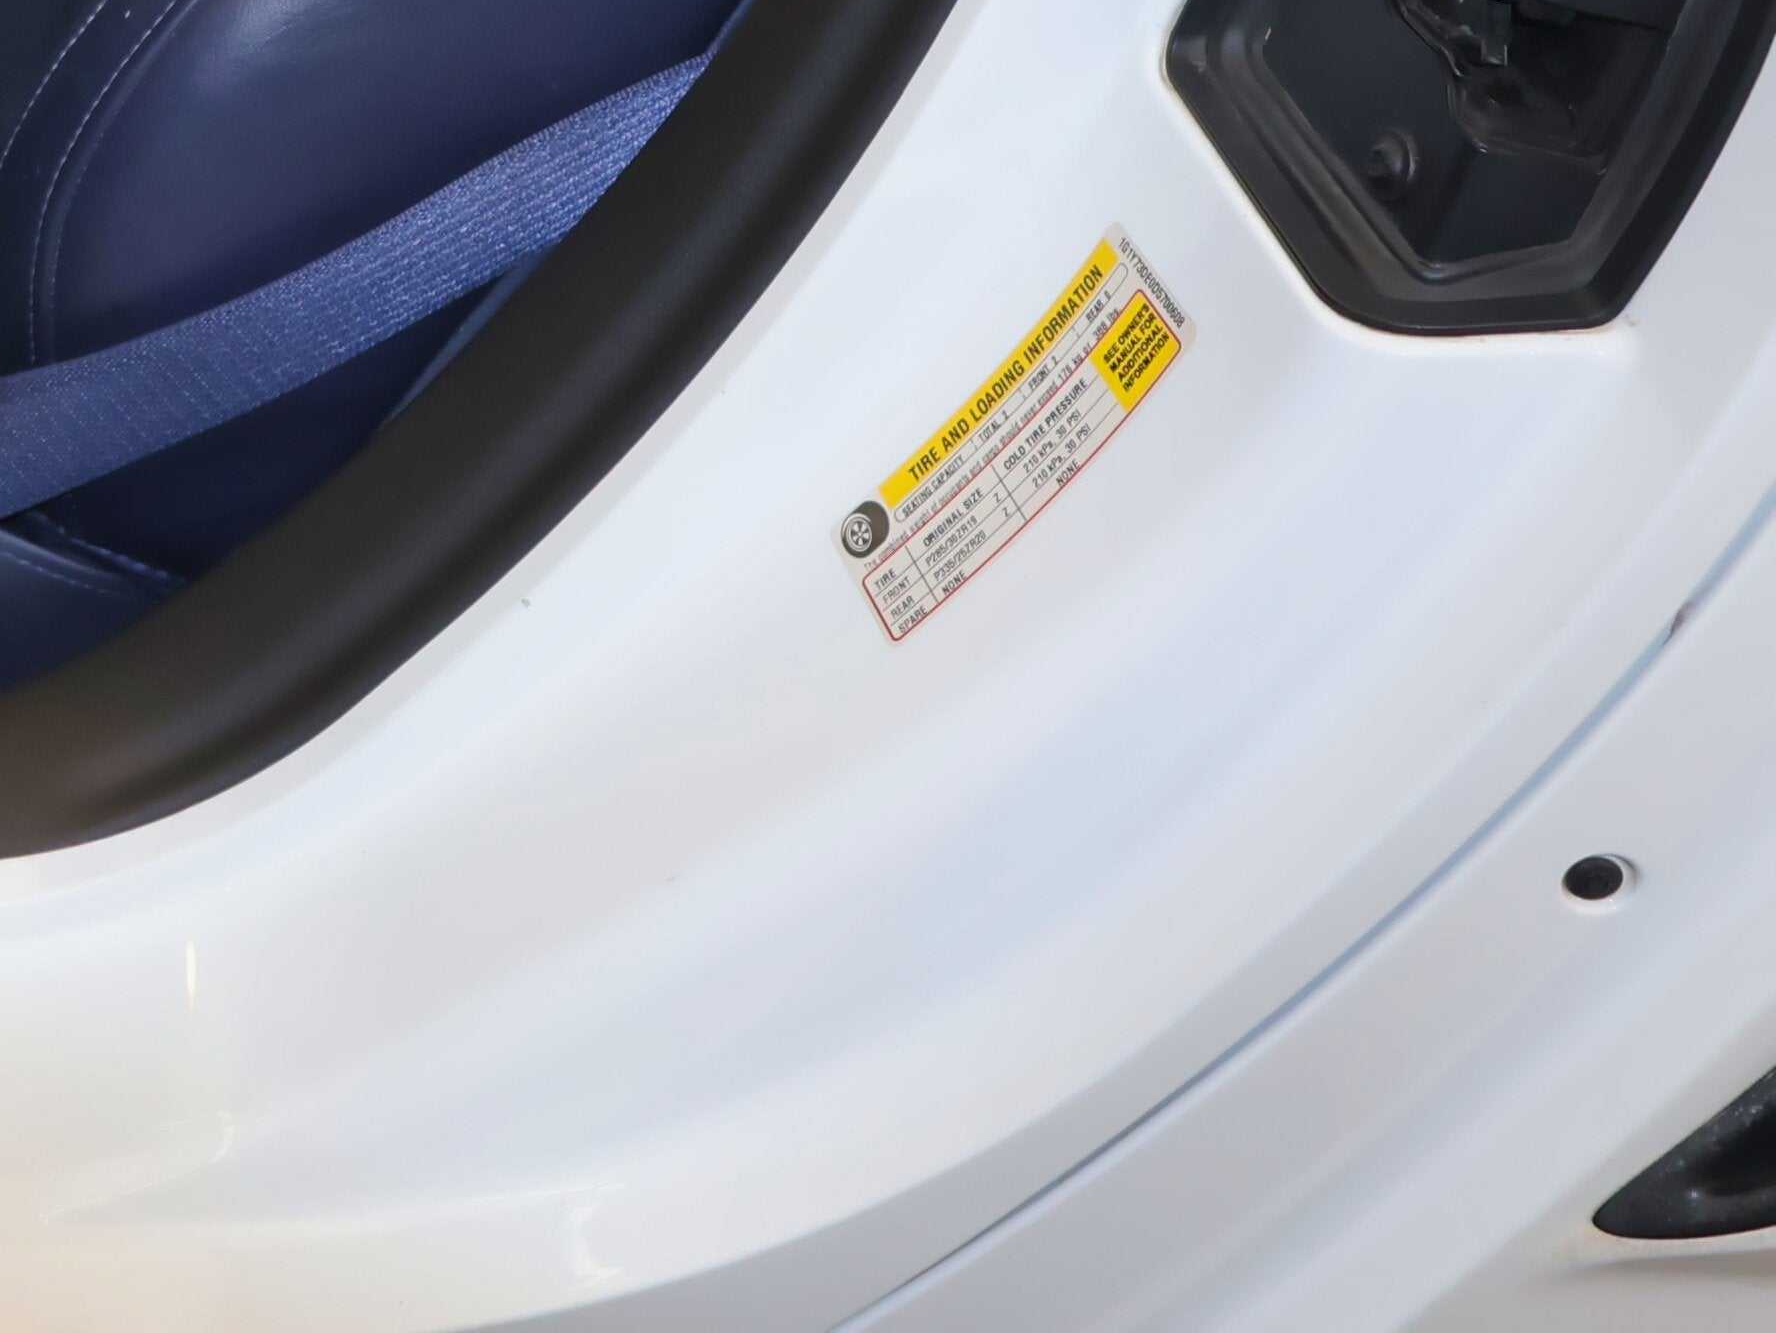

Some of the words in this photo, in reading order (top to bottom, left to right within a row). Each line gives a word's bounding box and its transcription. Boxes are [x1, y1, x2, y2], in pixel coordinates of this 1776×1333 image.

[1086, 299, 1104, 324] REAR
[1103, 342, 1120, 364] SEE
[1117, 302, 1150, 346] OWNER'S
[1108, 333, 1142, 374] MANUAL
[1139, 311, 1158, 335] FOR
[1117, 324, 1164, 382] ADDITIONAL
[1122, 332, 1170, 393] INFORMATION
[908, 446, 942, 482] TIRE
[941, 417, 970, 453] AND
[969, 359, 1026, 423] LOADING
[1023, 264, 1104, 365] INFORMATION
[1027, 364, 1050, 392] FRONT
[1051, 355, 1060, 366] 2
[1058, 364, 1073, 383] 176
[978, 419, 1002, 443] TOTAL
[1002, 409, 1010, 421] 2
[1002, 444, 1027, 470] COLD
[1024, 424, 1048, 448] TIRE
[1044, 377, 1088, 428] PRESSURE
[1022, 455, 1040, 474] 210
[1056, 424, 1068, 439] 30
[1066, 409, 1082, 427] PSI
[1032, 471, 1049, 489] 210
[1064, 439, 1077, 455] 30
[1075, 422, 1092, 442] PSI
[1055, 458, 1081, 487] NONE
[901, 488, 933, 517] SEATING
[931, 455, 965, 490] CAPACITY
[922, 509, 966, 549] ORIGINAL
[962, 487, 985, 511] SIZE
[875, 567, 898, 591] TIRE
[882, 576, 911, 605] FRONT
[941, 569, 967, 596] NONE
[890, 594, 915, 620] REAR
[897, 605, 928, 634] SPARE
